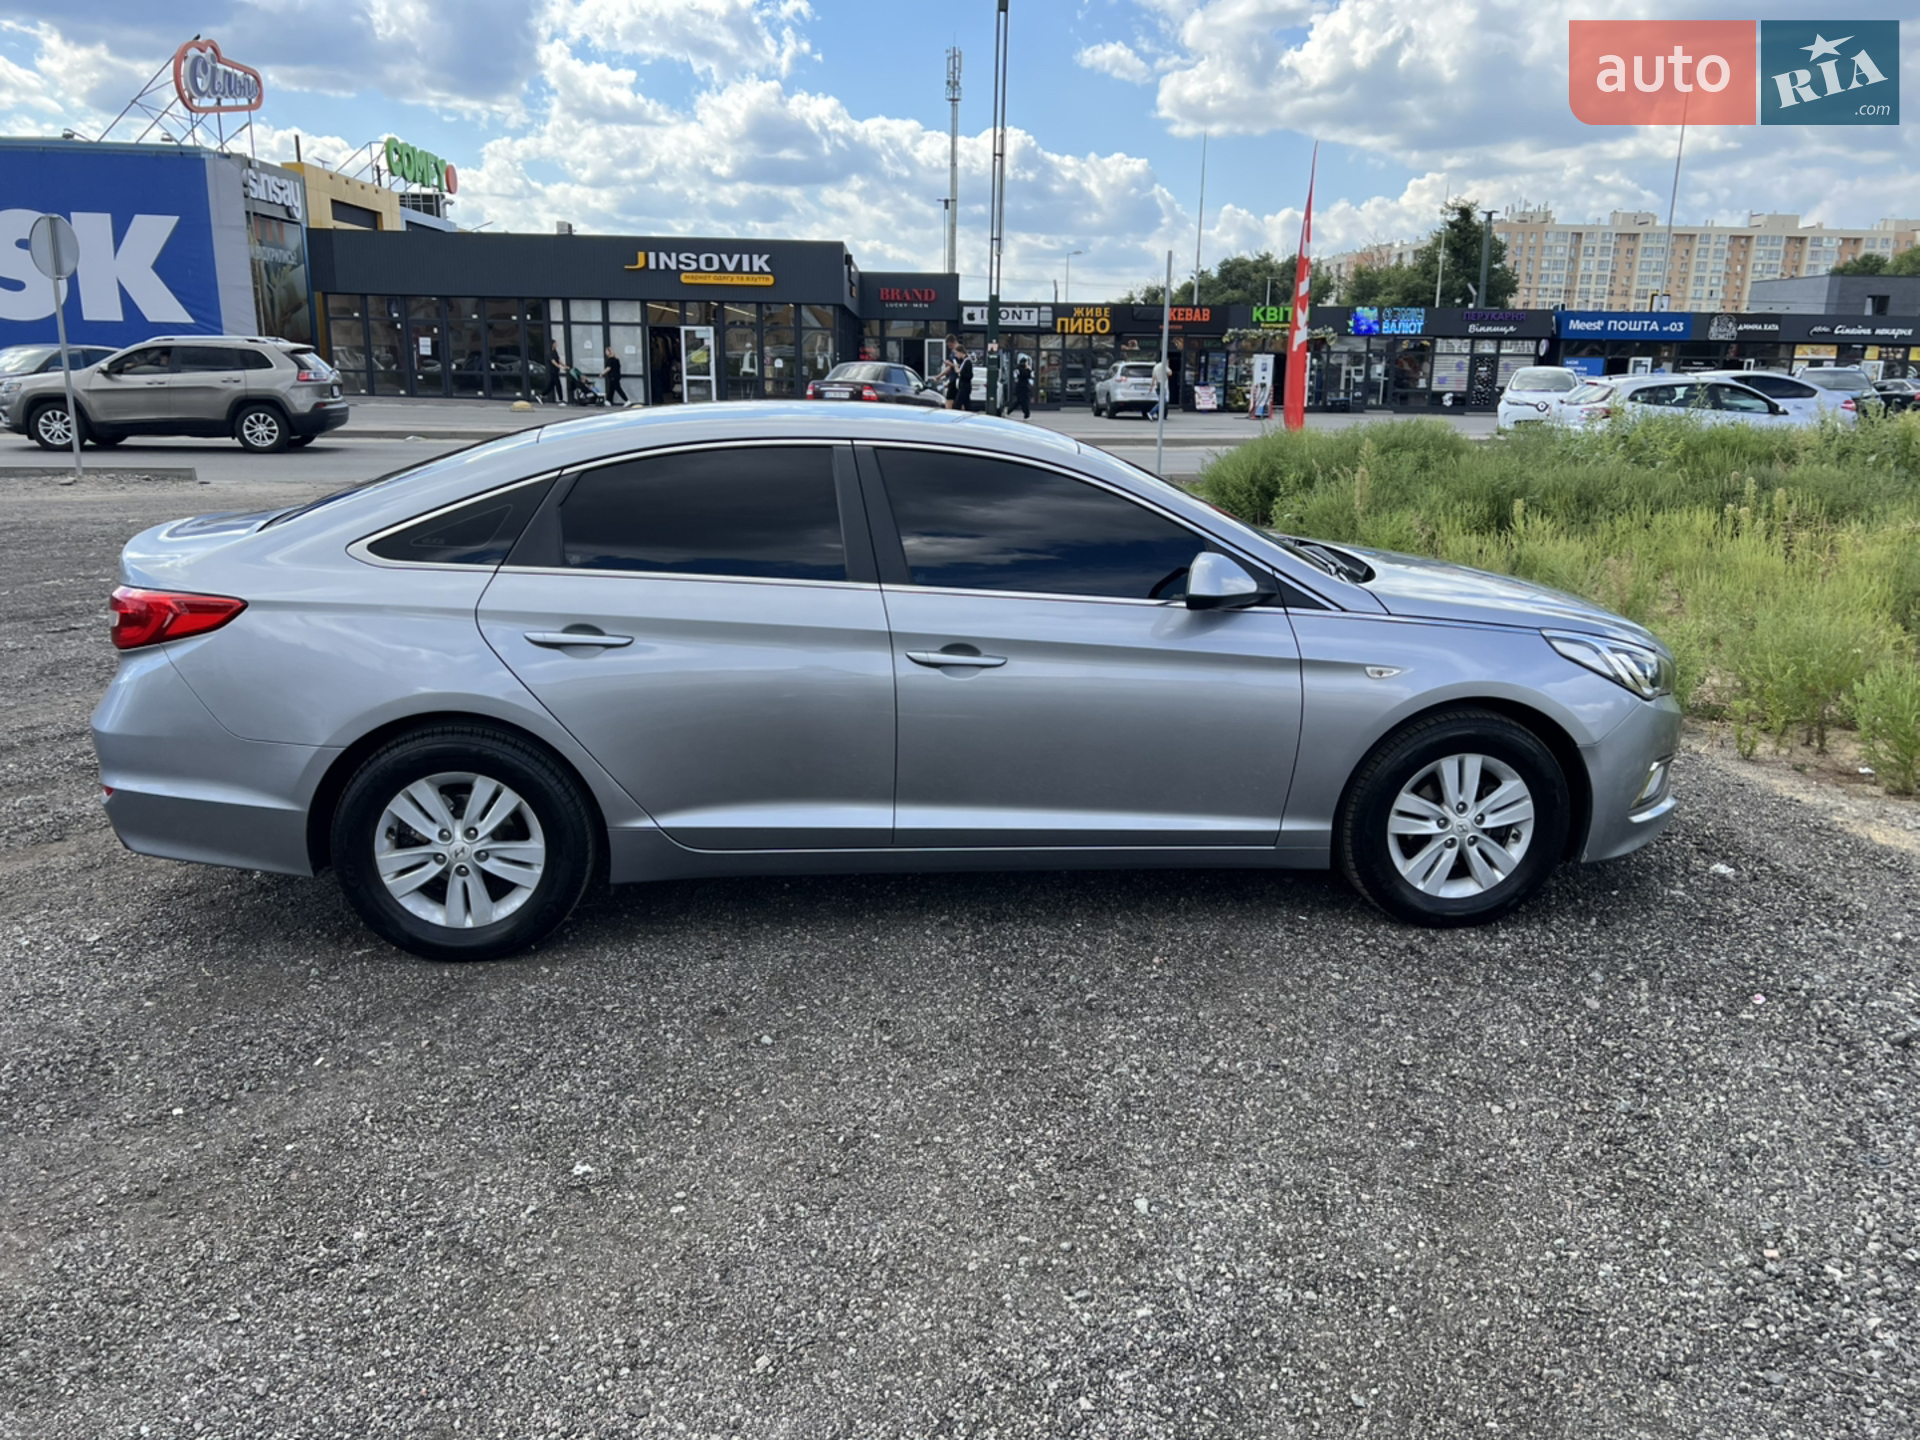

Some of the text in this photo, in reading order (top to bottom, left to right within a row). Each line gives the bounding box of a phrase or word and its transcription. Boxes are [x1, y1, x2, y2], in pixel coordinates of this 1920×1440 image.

[385, 137, 446, 192] COMFY
[624, 251, 771, 272] JINSOVIK
[880, 288, 936, 301] BRAND
[1073, 307, 1110, 318] ЖИВЕ
[1463, 311, 1526, 321] ПЕРУКАРНЯ
[1056, 317, 1111, 334] ПИВО
[1382, 321, 1424, 334] ВАЛЮТ
[1607, 320, 1659, 331] ПОШТА
